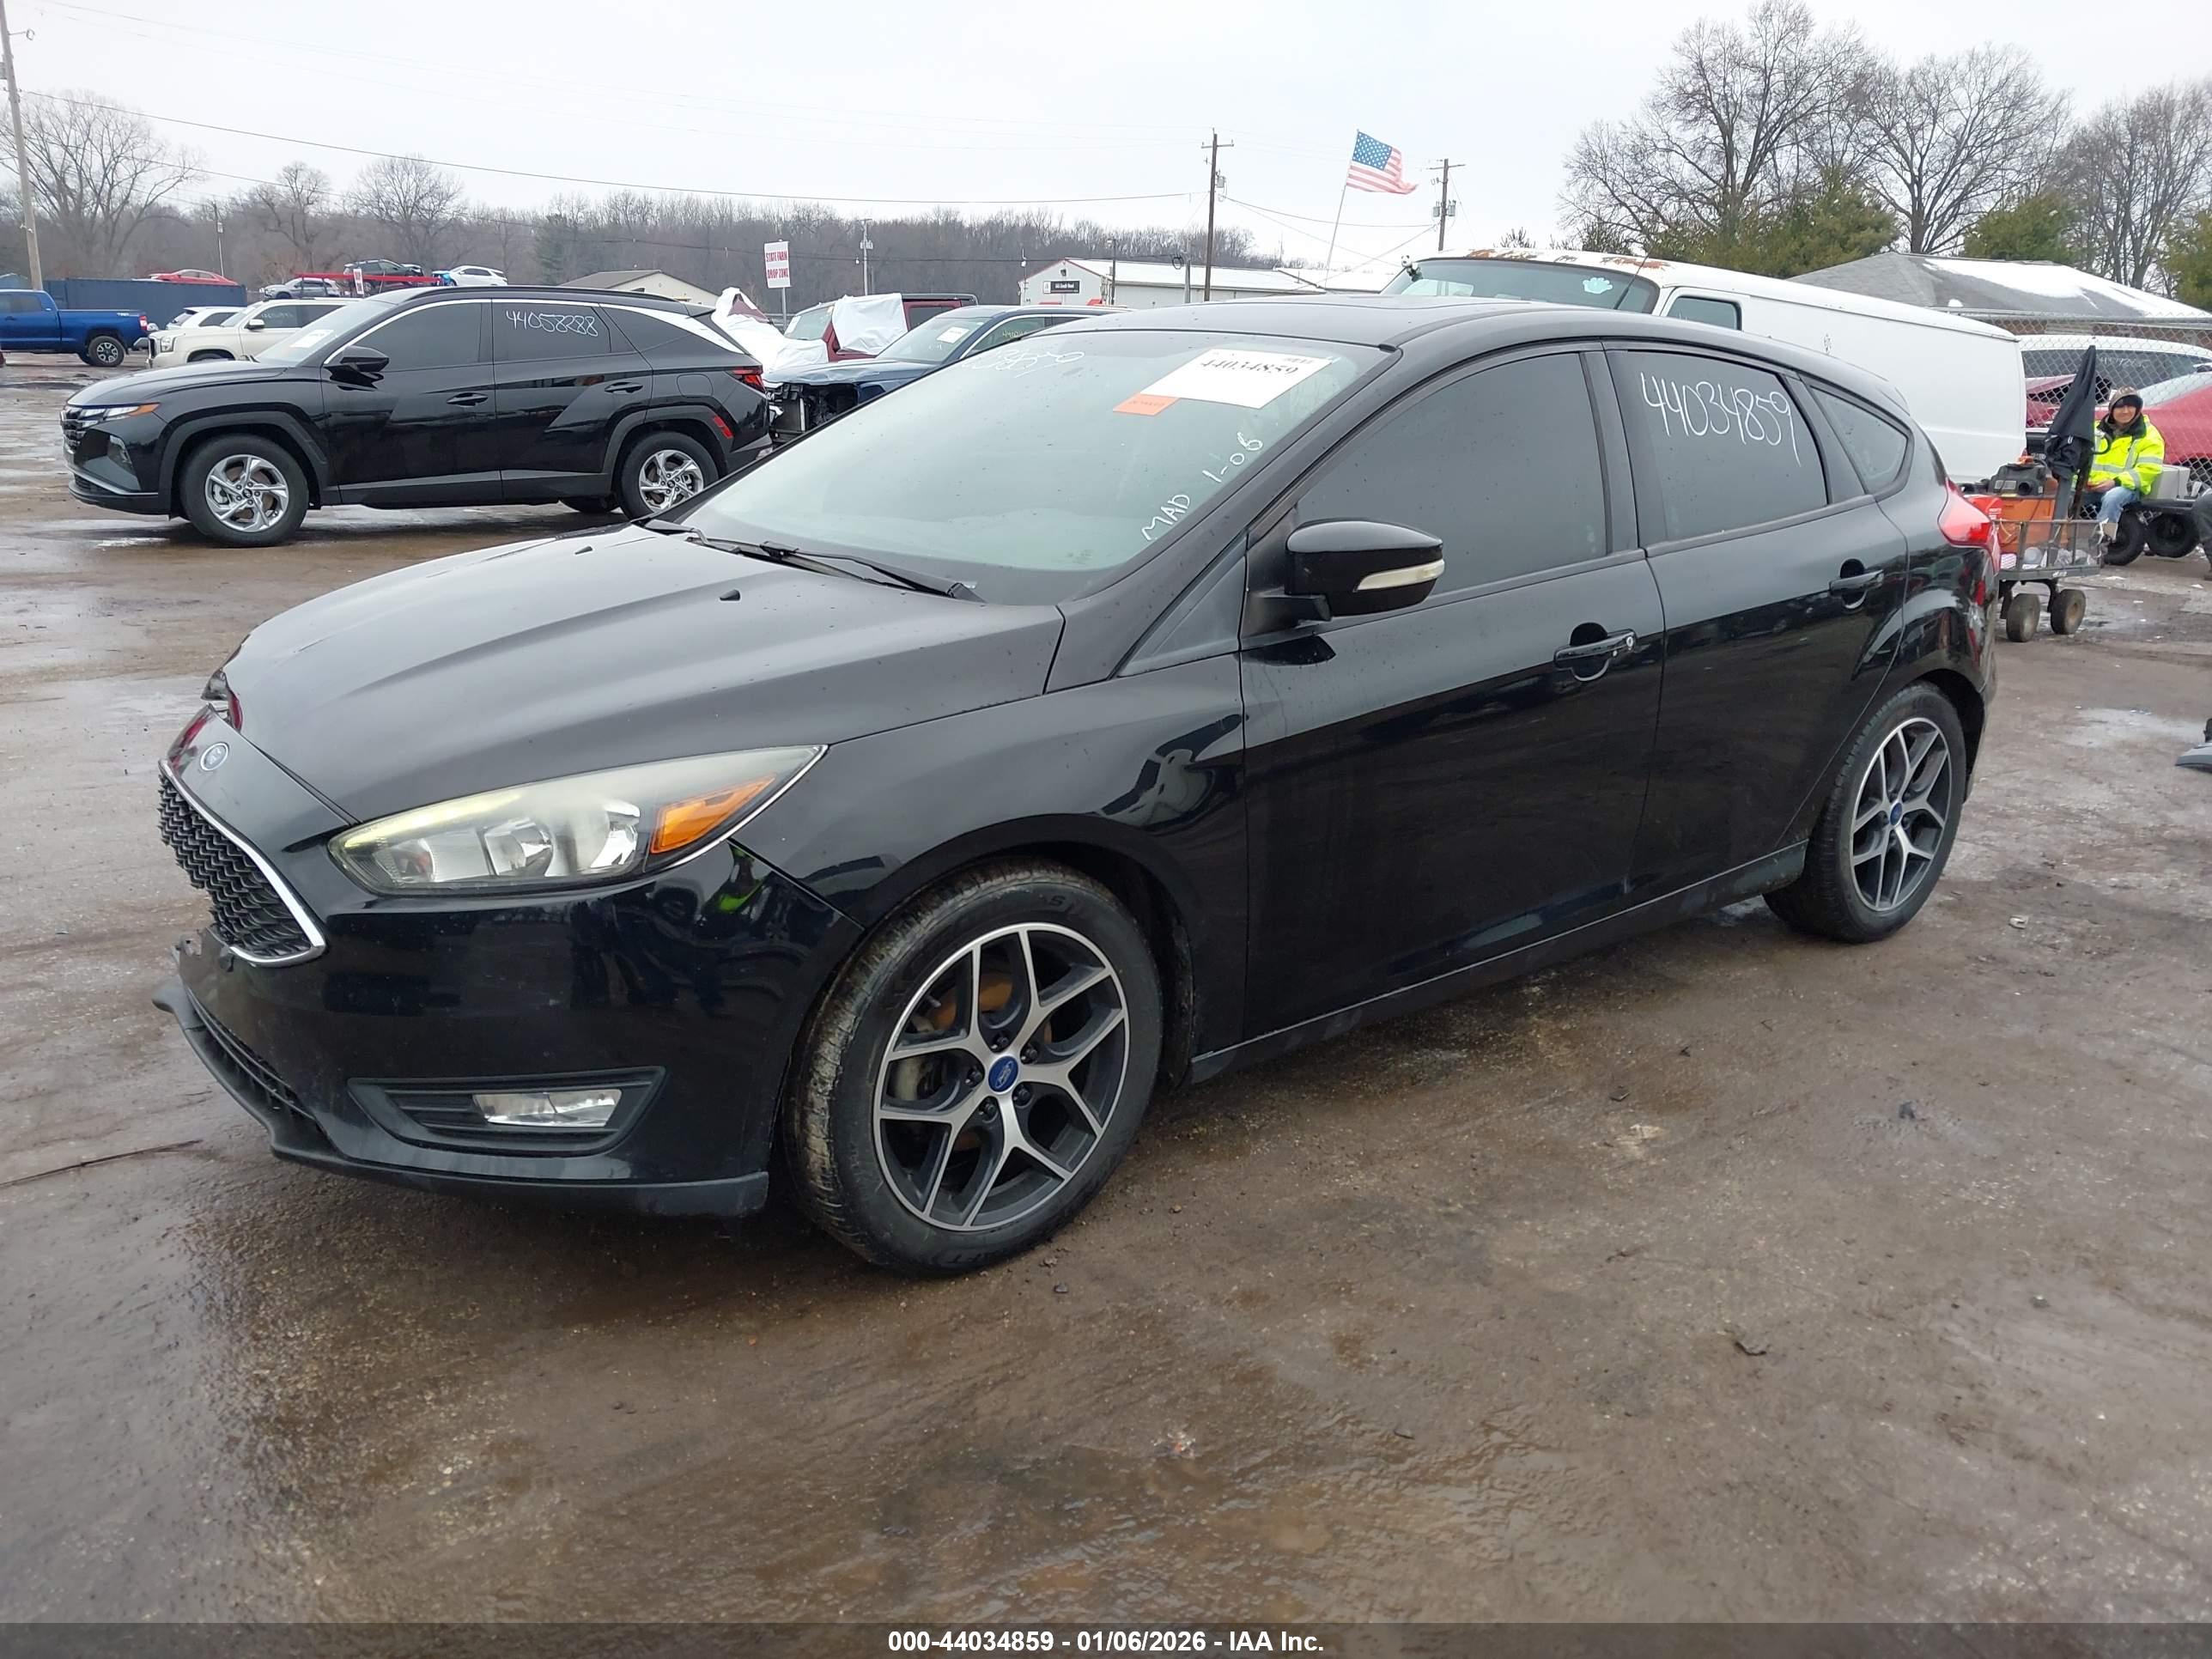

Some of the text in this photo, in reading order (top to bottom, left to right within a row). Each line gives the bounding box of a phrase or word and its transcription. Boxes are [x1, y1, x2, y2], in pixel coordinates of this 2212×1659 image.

[765, 251, 788, 263] STATE FARM
[1640, 372, 1802, 467] 44034859
[1141, 431, 1263, 541] MAD 1-06
